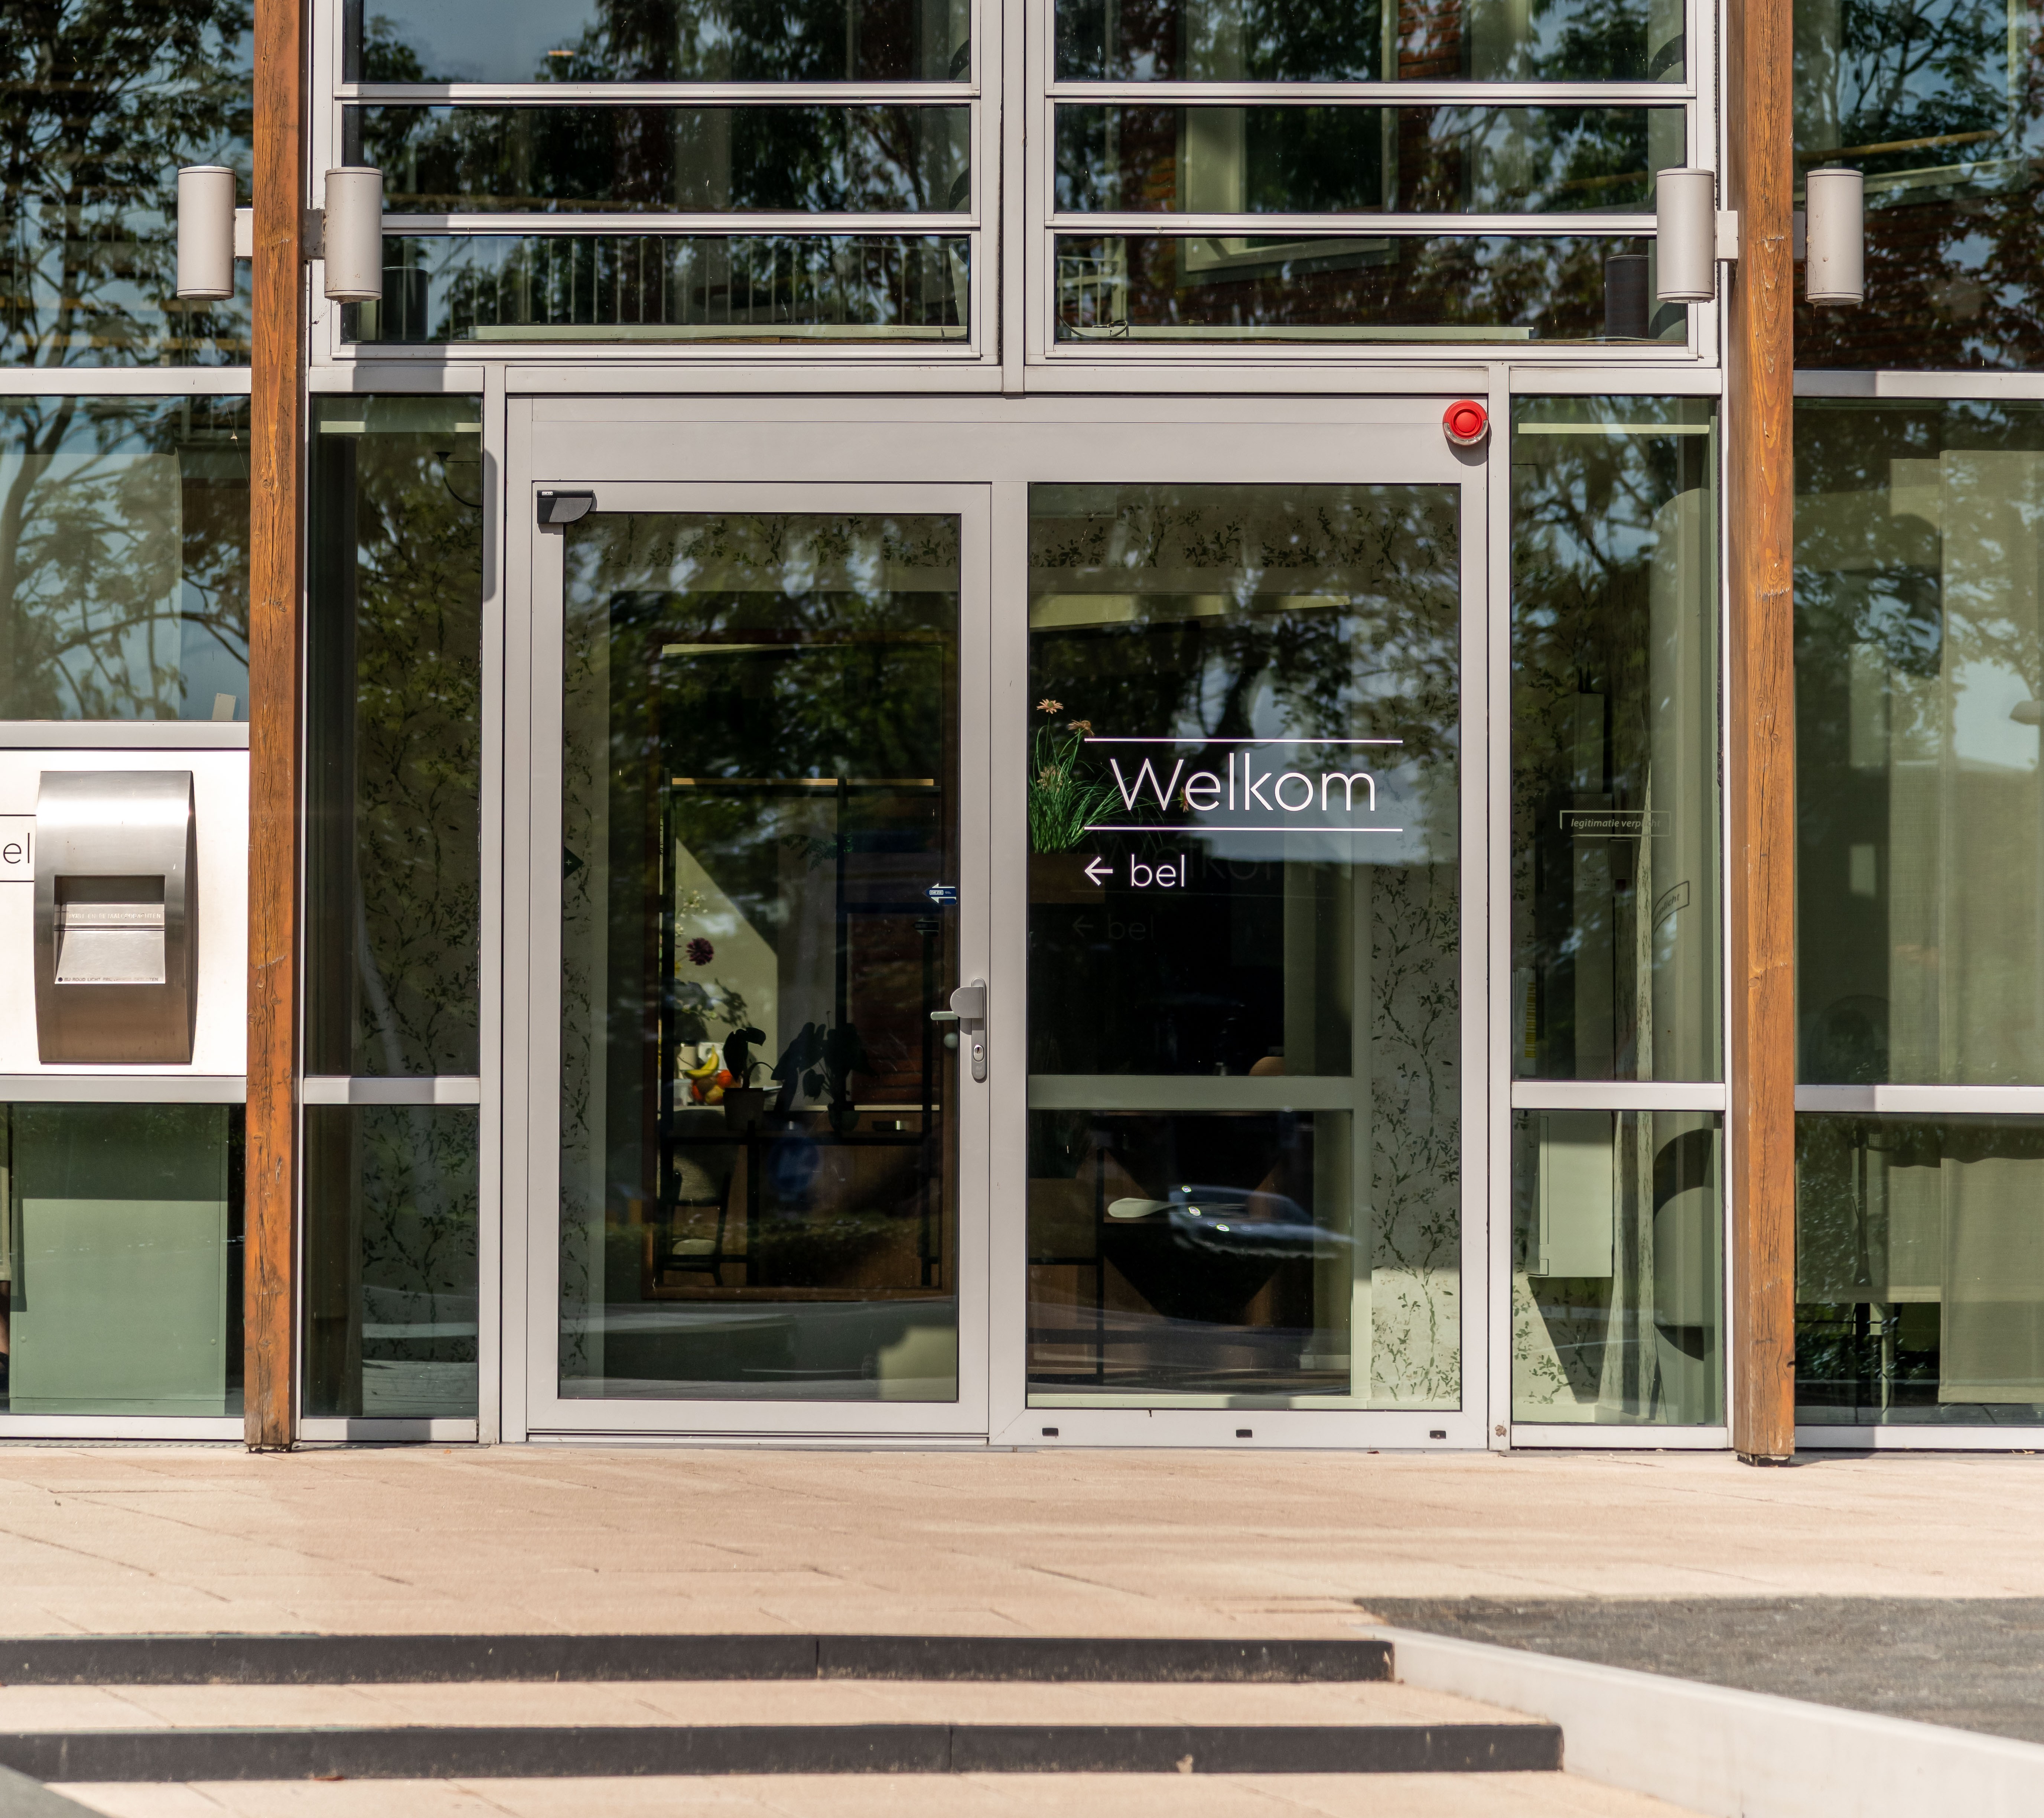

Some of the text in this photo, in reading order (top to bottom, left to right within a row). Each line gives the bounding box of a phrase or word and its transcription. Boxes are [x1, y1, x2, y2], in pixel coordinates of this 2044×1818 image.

[1111, 753, 1374, 811] Welkom
[1571, 819, 1619, 829] legitimatie
[3, 833, 30, 864] el
[1131, 854, 1185, 887] bel
